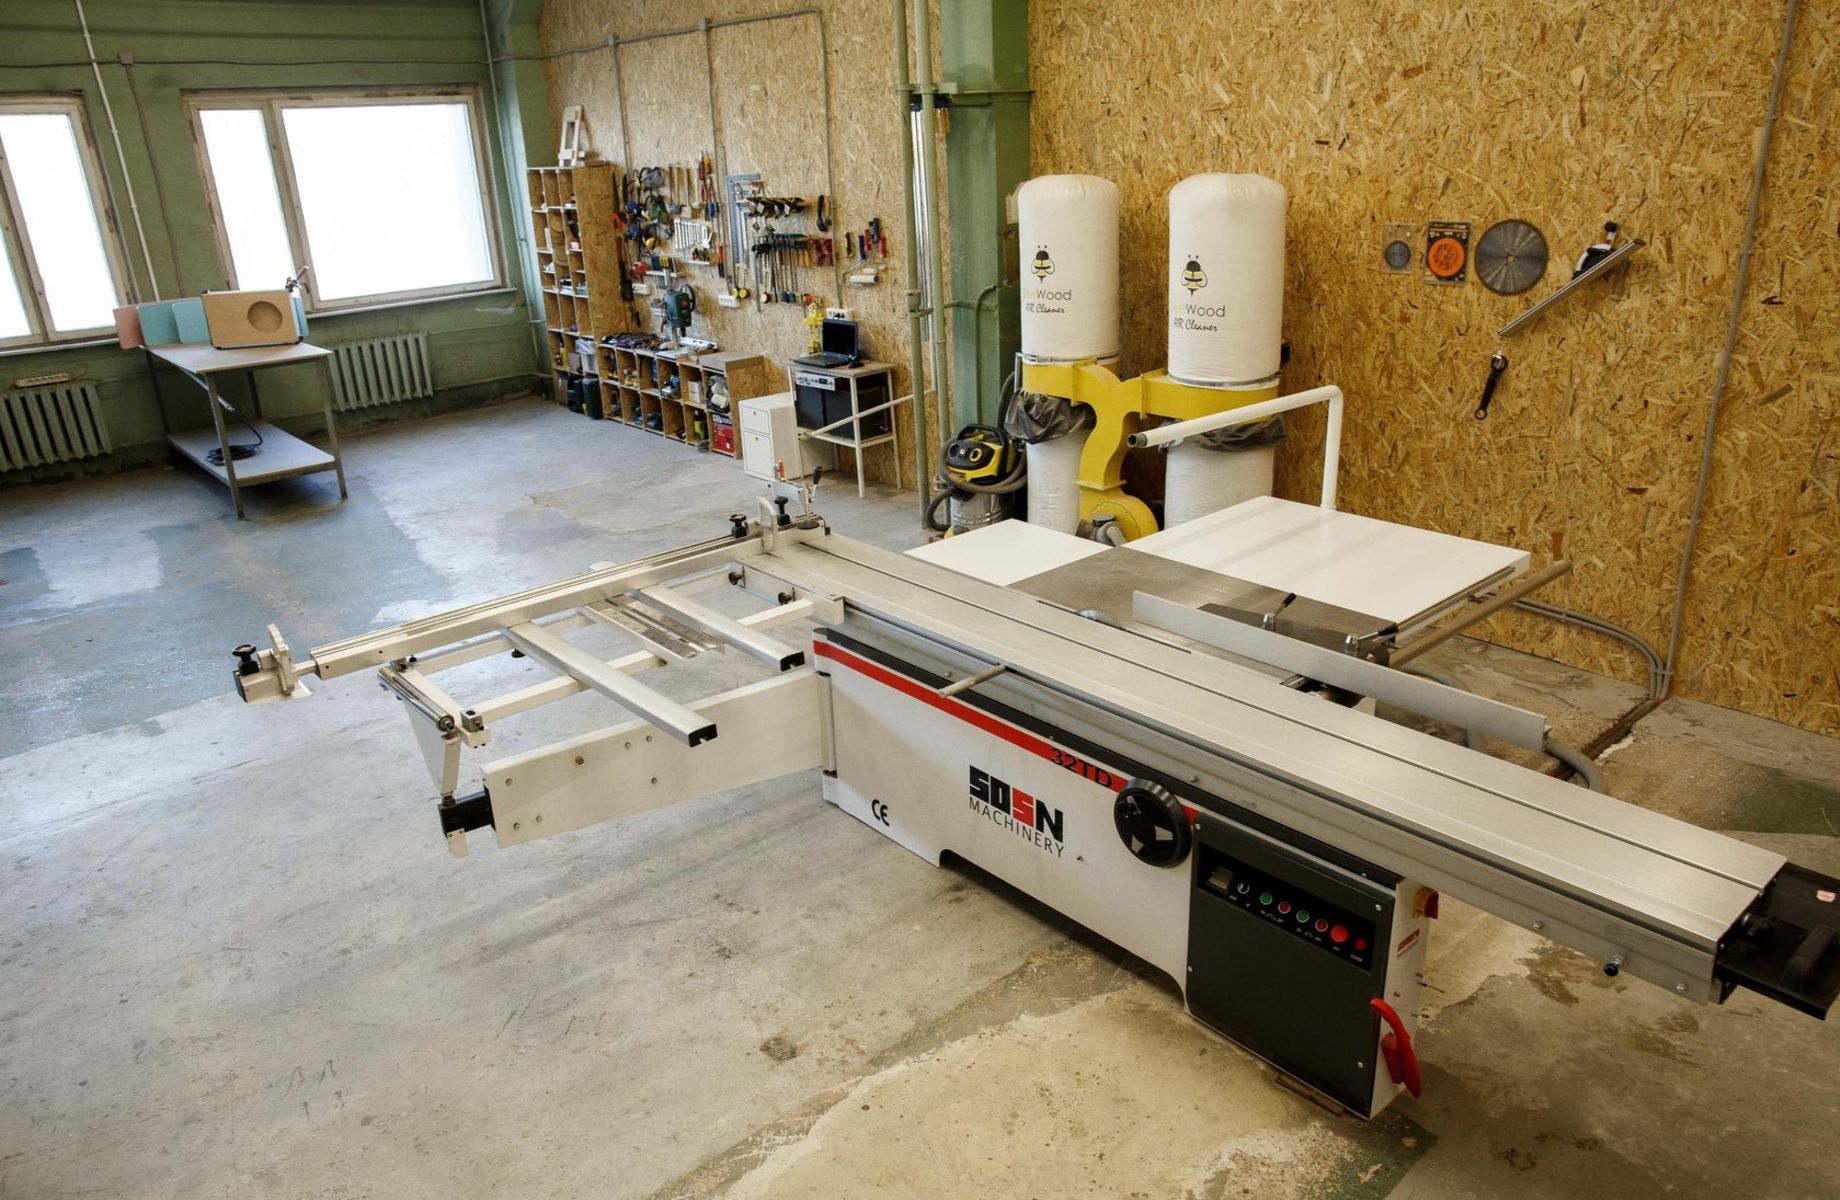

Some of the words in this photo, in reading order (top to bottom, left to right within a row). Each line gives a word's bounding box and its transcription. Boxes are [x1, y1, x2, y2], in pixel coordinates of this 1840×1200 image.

[1035, 303, 1065, 313] Cleaner
[1185, 318, 1218, 331] Cleaner
[1051, 747, 1113, 788] 32TD
[969, 764, 1064, 843] SOSN
[969, 796, 1065, 858] MACHINERY
